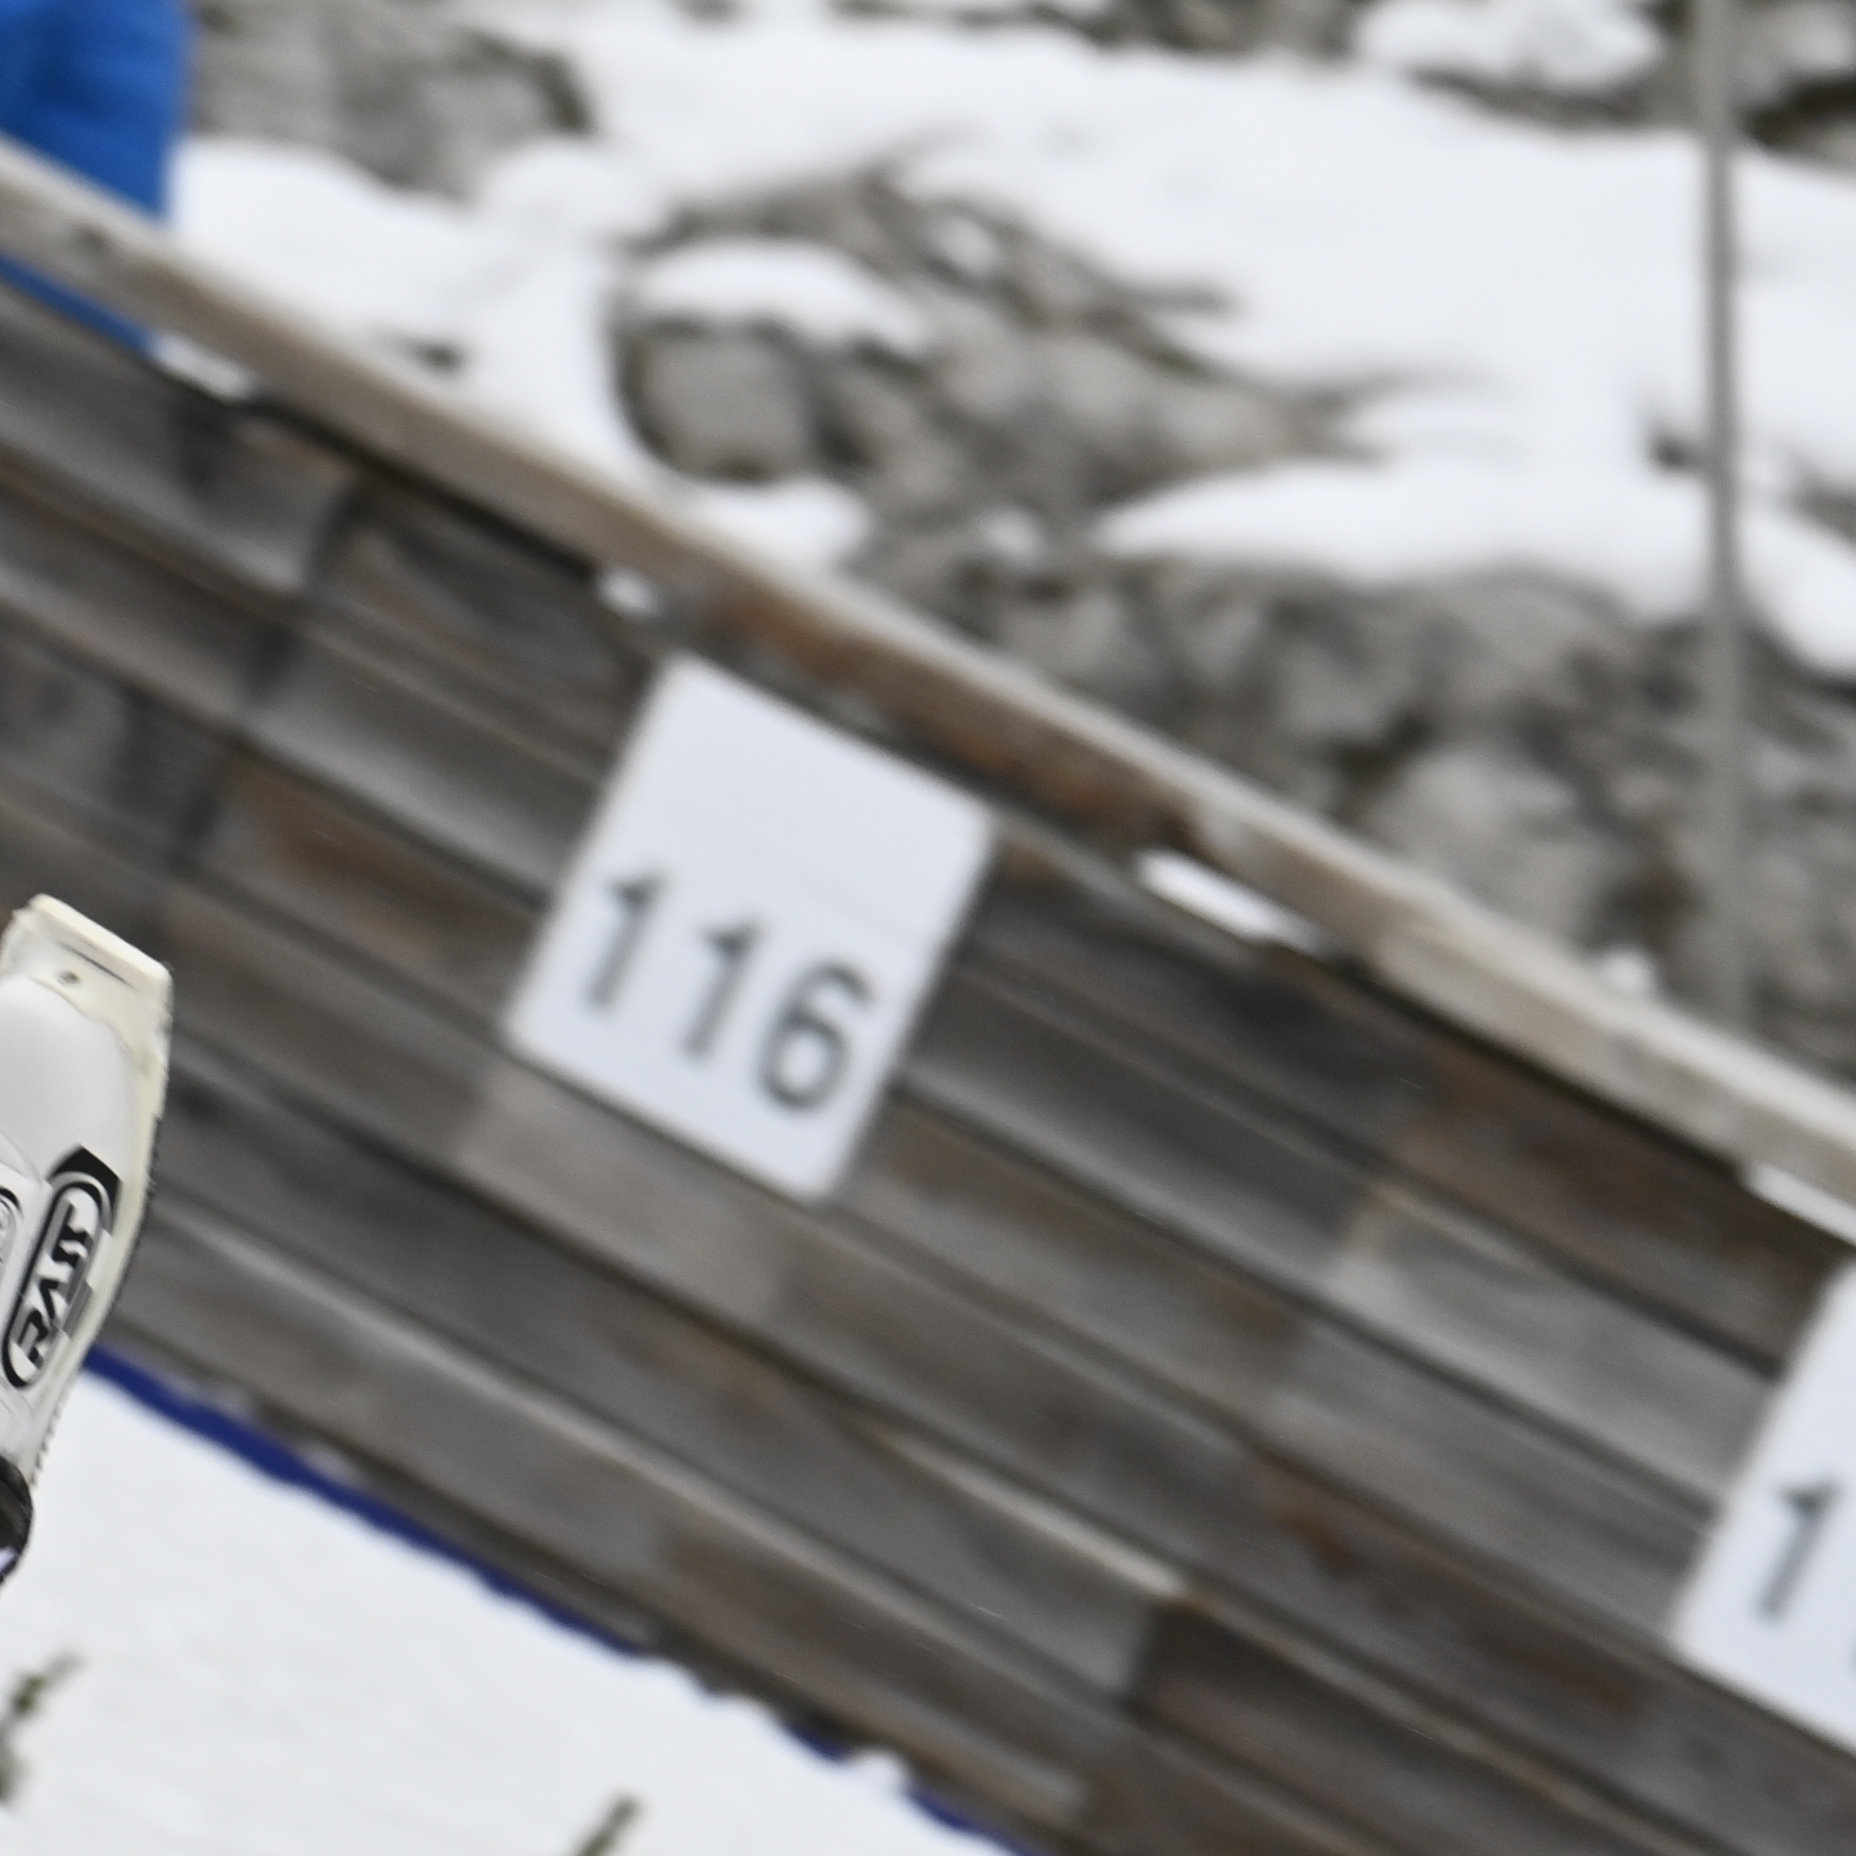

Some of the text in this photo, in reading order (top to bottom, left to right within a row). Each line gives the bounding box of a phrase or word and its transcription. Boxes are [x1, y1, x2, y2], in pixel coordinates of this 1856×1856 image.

[581, 870, 875, 1115] 116
[16, 1202, 92, 1364] RASS
[1754, 1477, 1856, 1640] 1
